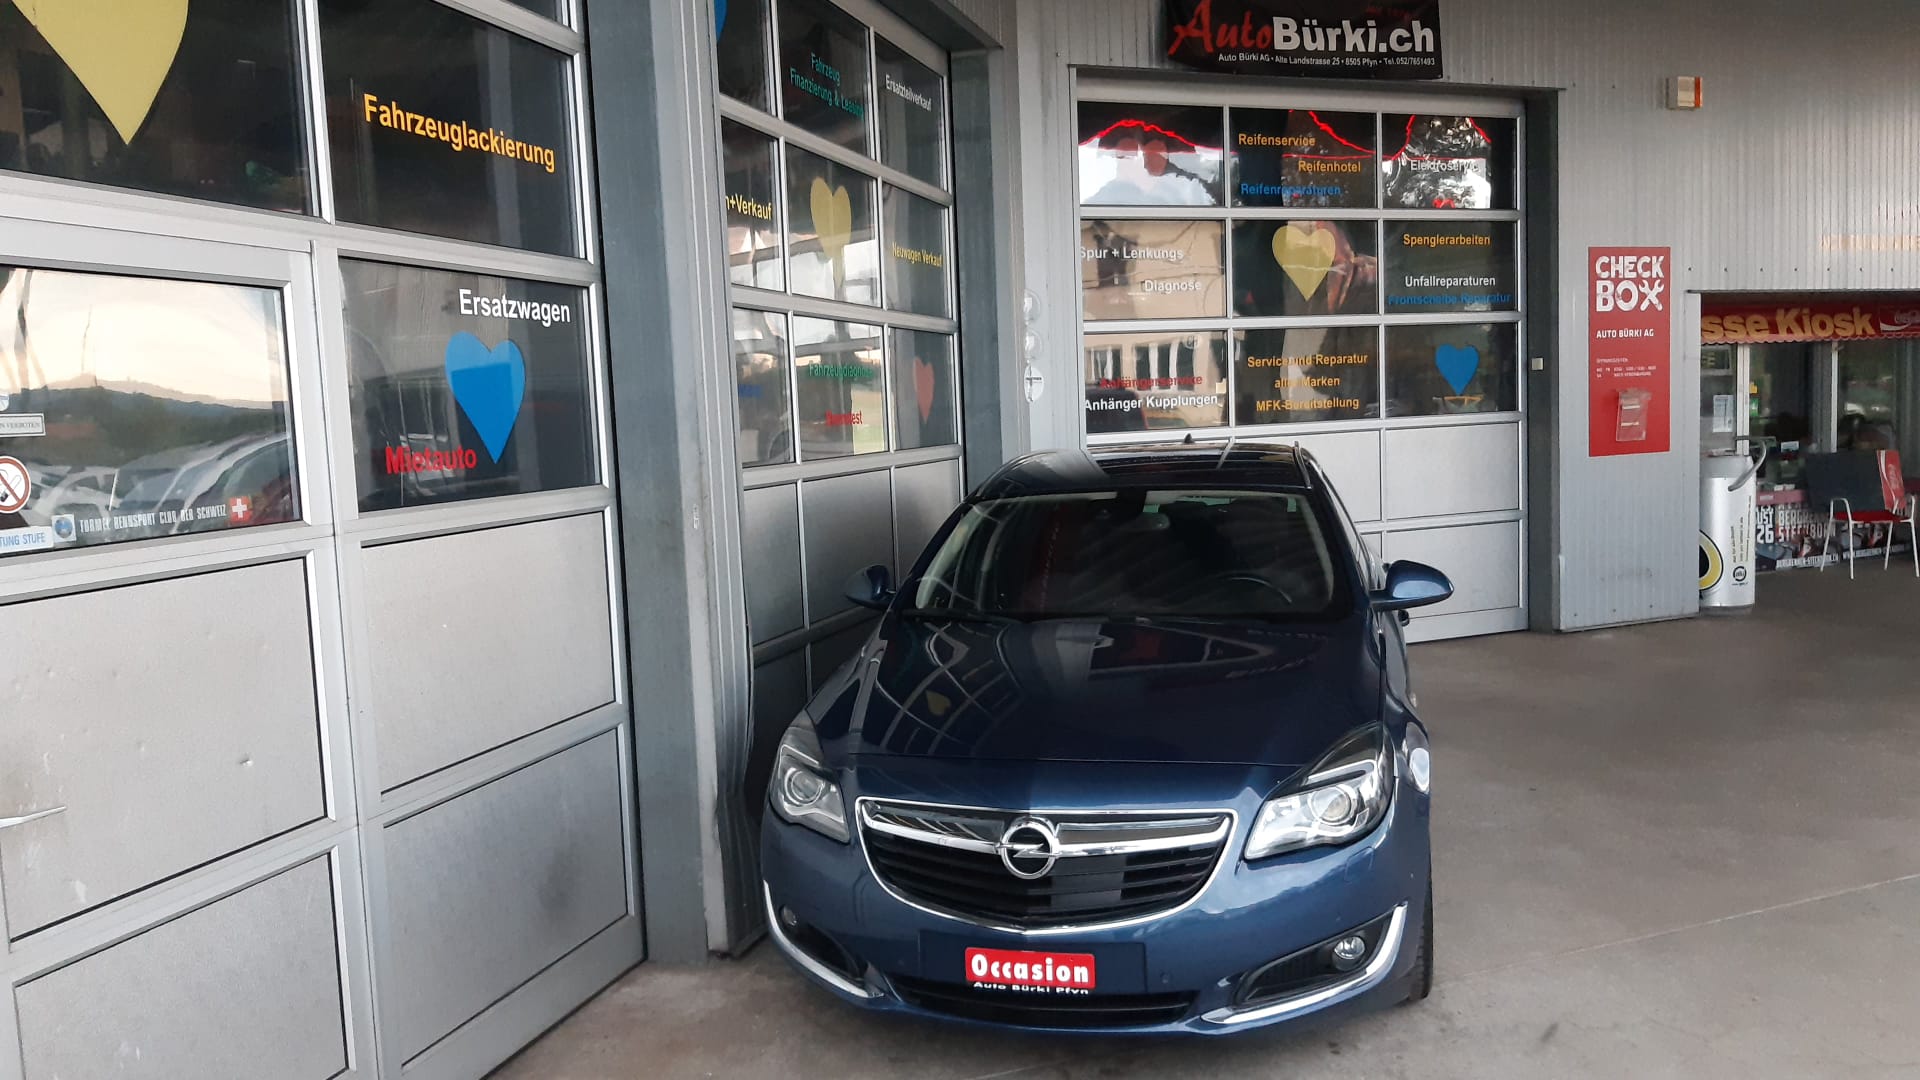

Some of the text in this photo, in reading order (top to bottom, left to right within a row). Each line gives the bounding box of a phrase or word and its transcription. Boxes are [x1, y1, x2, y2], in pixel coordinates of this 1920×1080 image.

[1218, 53, 1236, 62] Auto
[1239, 52, 1258, 61] Bürki
[1260, 54, 1270, 62] AG
[1289, 56, 1330, 65] Landstrasse
[1332, 57, 1340, 65] 25
[1362, 58, 1378, 68] Pfyn
[810, 52, 841, 87] Fahrzeug
[790, 66, 833, 107] Finanzierung
[834, 89, 840, 107] &
[885, 74, 932, 112] Ersatzteilverkauf
[363, 93, 555, 173] Fahrzeuglackierung
[1238, 134, 1316, 146] Reifenservice
[1298, 160, 1362, 172] Reifenhotel
[1240, 182, 1342, 197] Reifenreparaturen
[1402, 233, 1491, 248] Spenglerarbeiten
[892, 242, 942, 268] Neuwagen Verkauf
[1080, 246, 1108, 262] Spur
[1123, 246, 1185, 261] Lenkungs
[1595, 256, 1665, 279] CHECK
[1144, 280, 1202, 294] Diagnose
[1404, 275, 1496, 289] Unfallreparaturen
[1596, 279, 1665, 312] BOX
[458, 288, 571, 328] Ersatzwagen
[1775, 306, 1876, 338] Kiosk
[1596, 327, 1655, 339] AUTO BÜRKI AG
[1247, 356, 1288, 368] Service
[1315, 353, 1368, 367] Reparatur
[1301, 376, 1340, 388] Marken
[1084, 393, 1218, 412] Anhänger Kupplungen
[385, 445, 478, 475] Mietauto
[197, 504, 228, 519] SCHWEIZ
[22, 532, 46, 545] STUFE
[1756, 525, 1774, 545] 26
[971, 954, 1089, 983] Occasion
[974, 982, 1006, 990] Auto
[1011, 984, 1050, 993] Bürki
